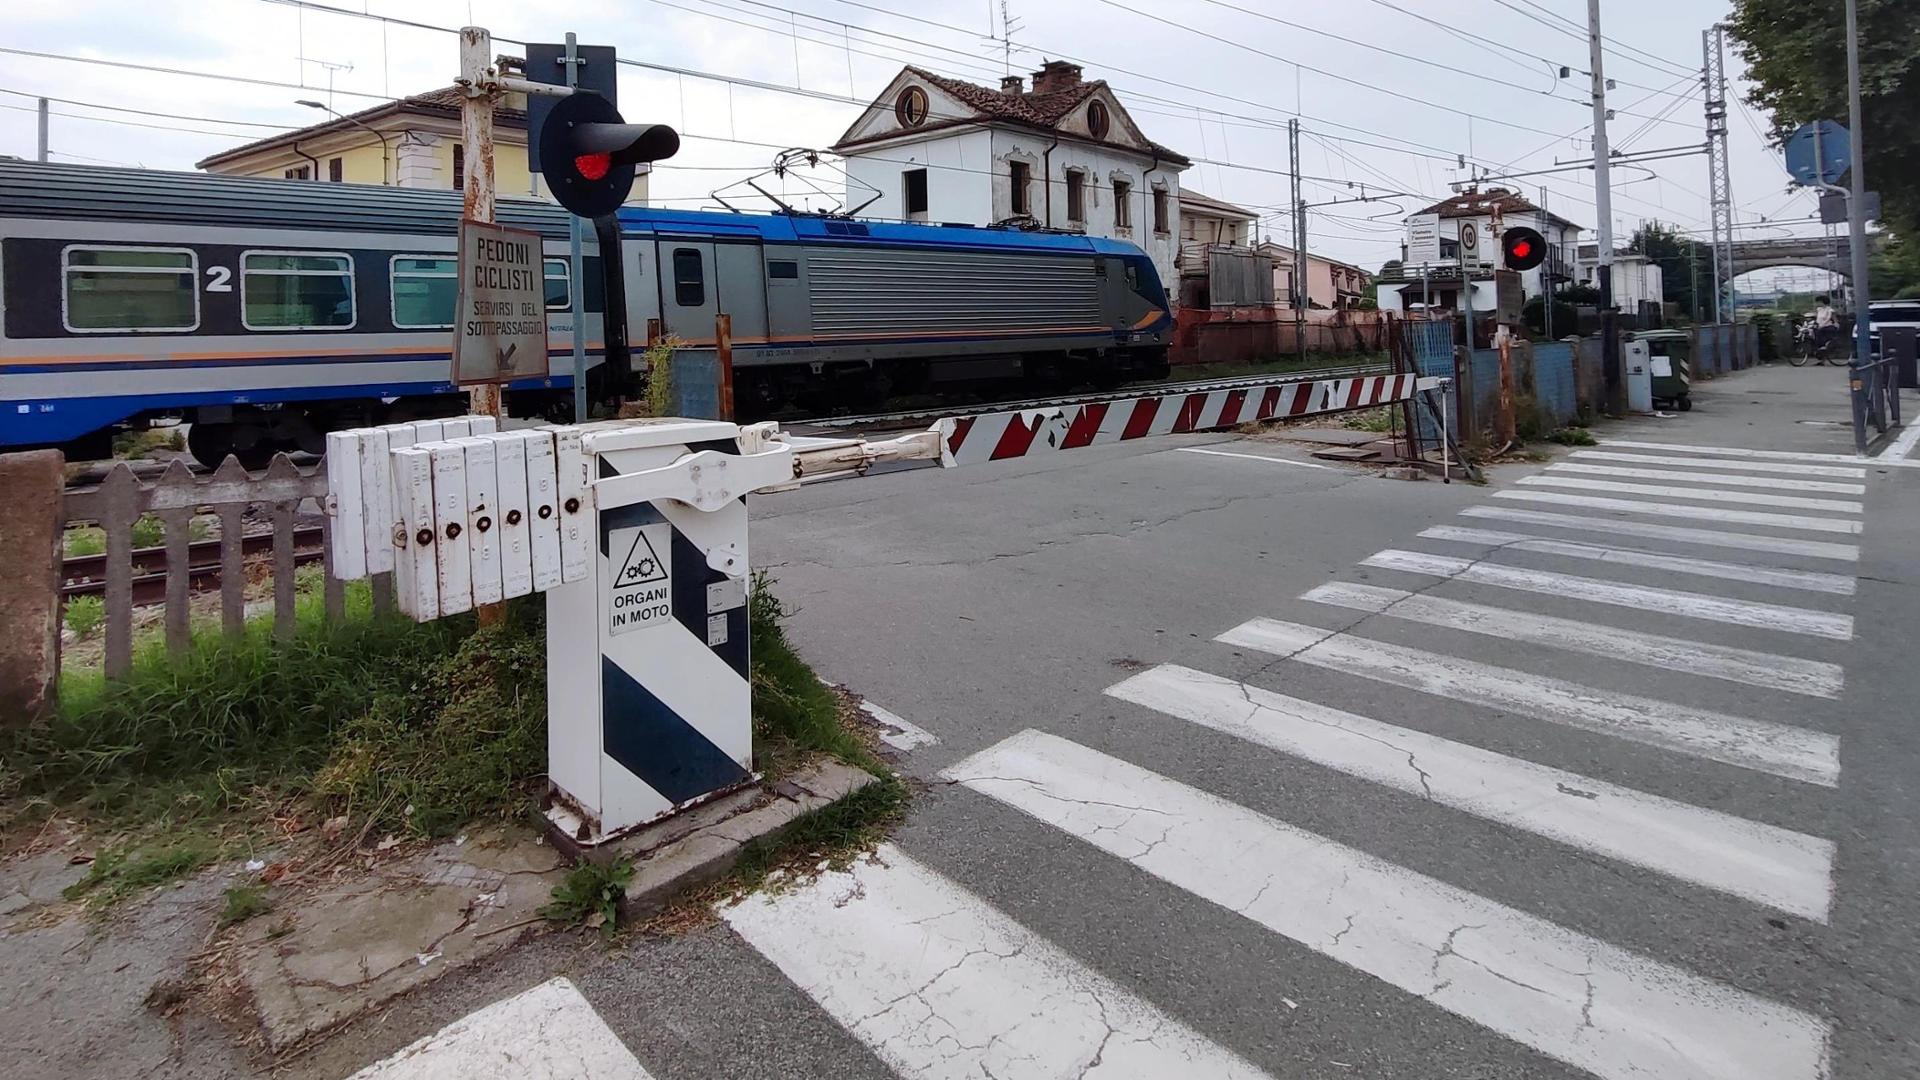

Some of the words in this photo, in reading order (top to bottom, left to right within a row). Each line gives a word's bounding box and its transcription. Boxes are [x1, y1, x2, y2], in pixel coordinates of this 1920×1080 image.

[477, 237, 529, 265] PEDONI
[206, 265, 232, 292] 2
[474, 265, 534, 291] CICLISTI
[473, 301, 514, 316] SERVIRSI
[521, 302, 538, 317] DEL
[466, 320, 543, 337] SOTTOPASSAGGIO
[614, 587, 668, 609] ORGANI
[612, 613, 626, 627] IN
[630, 604, 669, 623] MOTO
